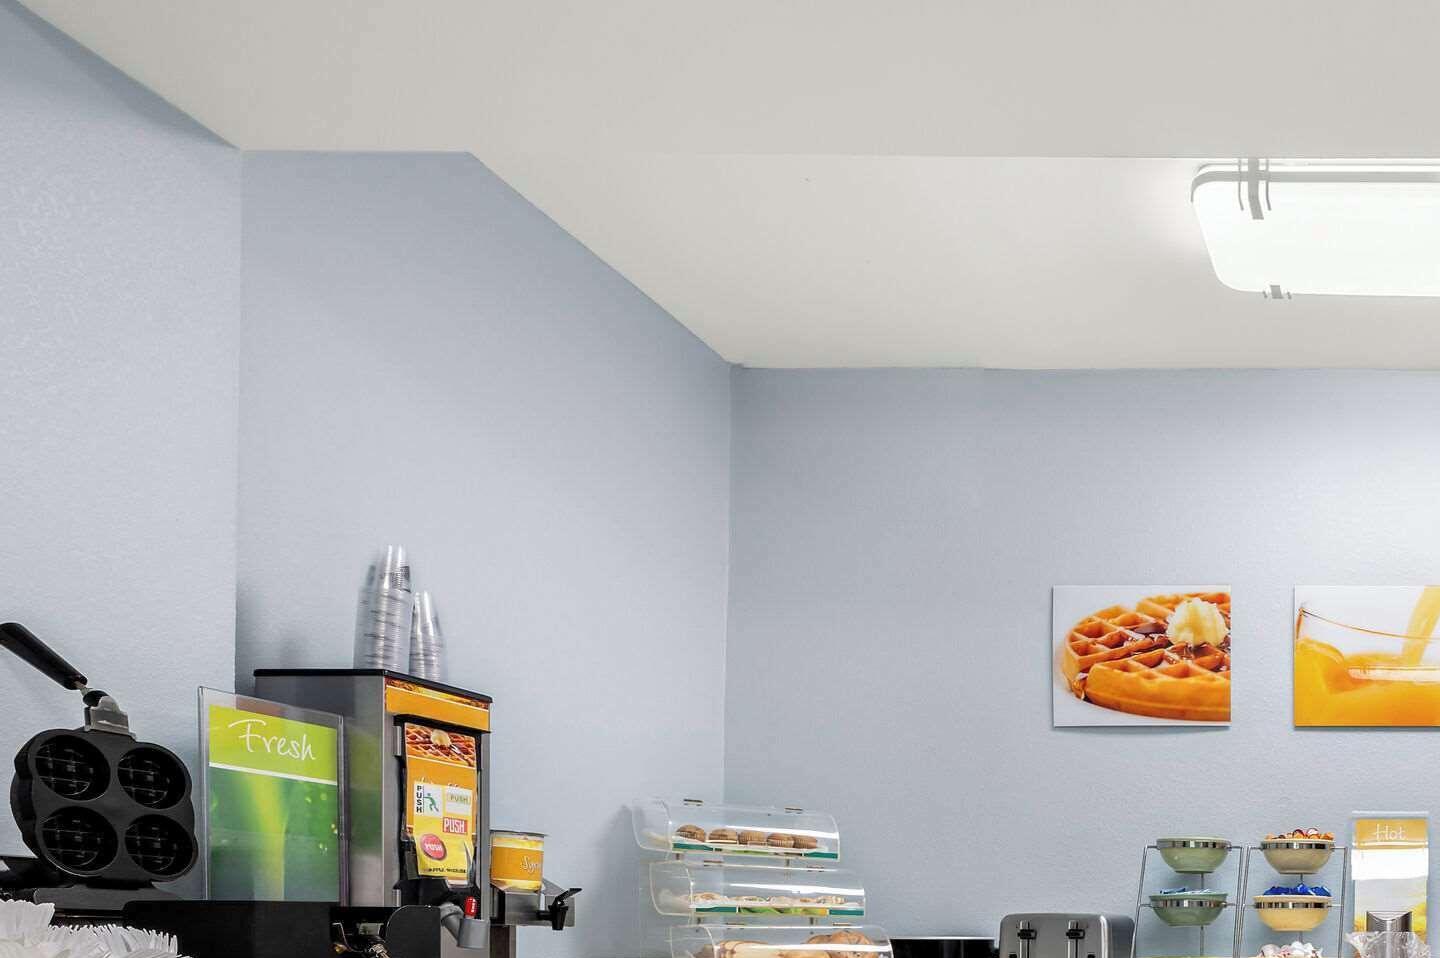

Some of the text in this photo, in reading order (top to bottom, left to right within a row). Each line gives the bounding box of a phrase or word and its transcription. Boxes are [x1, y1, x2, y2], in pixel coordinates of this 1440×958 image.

[228, 719, 316, 761] Fresh
[443, 818, 465, 833] PUSH
[1370, 823, 1407, 842] Hot
